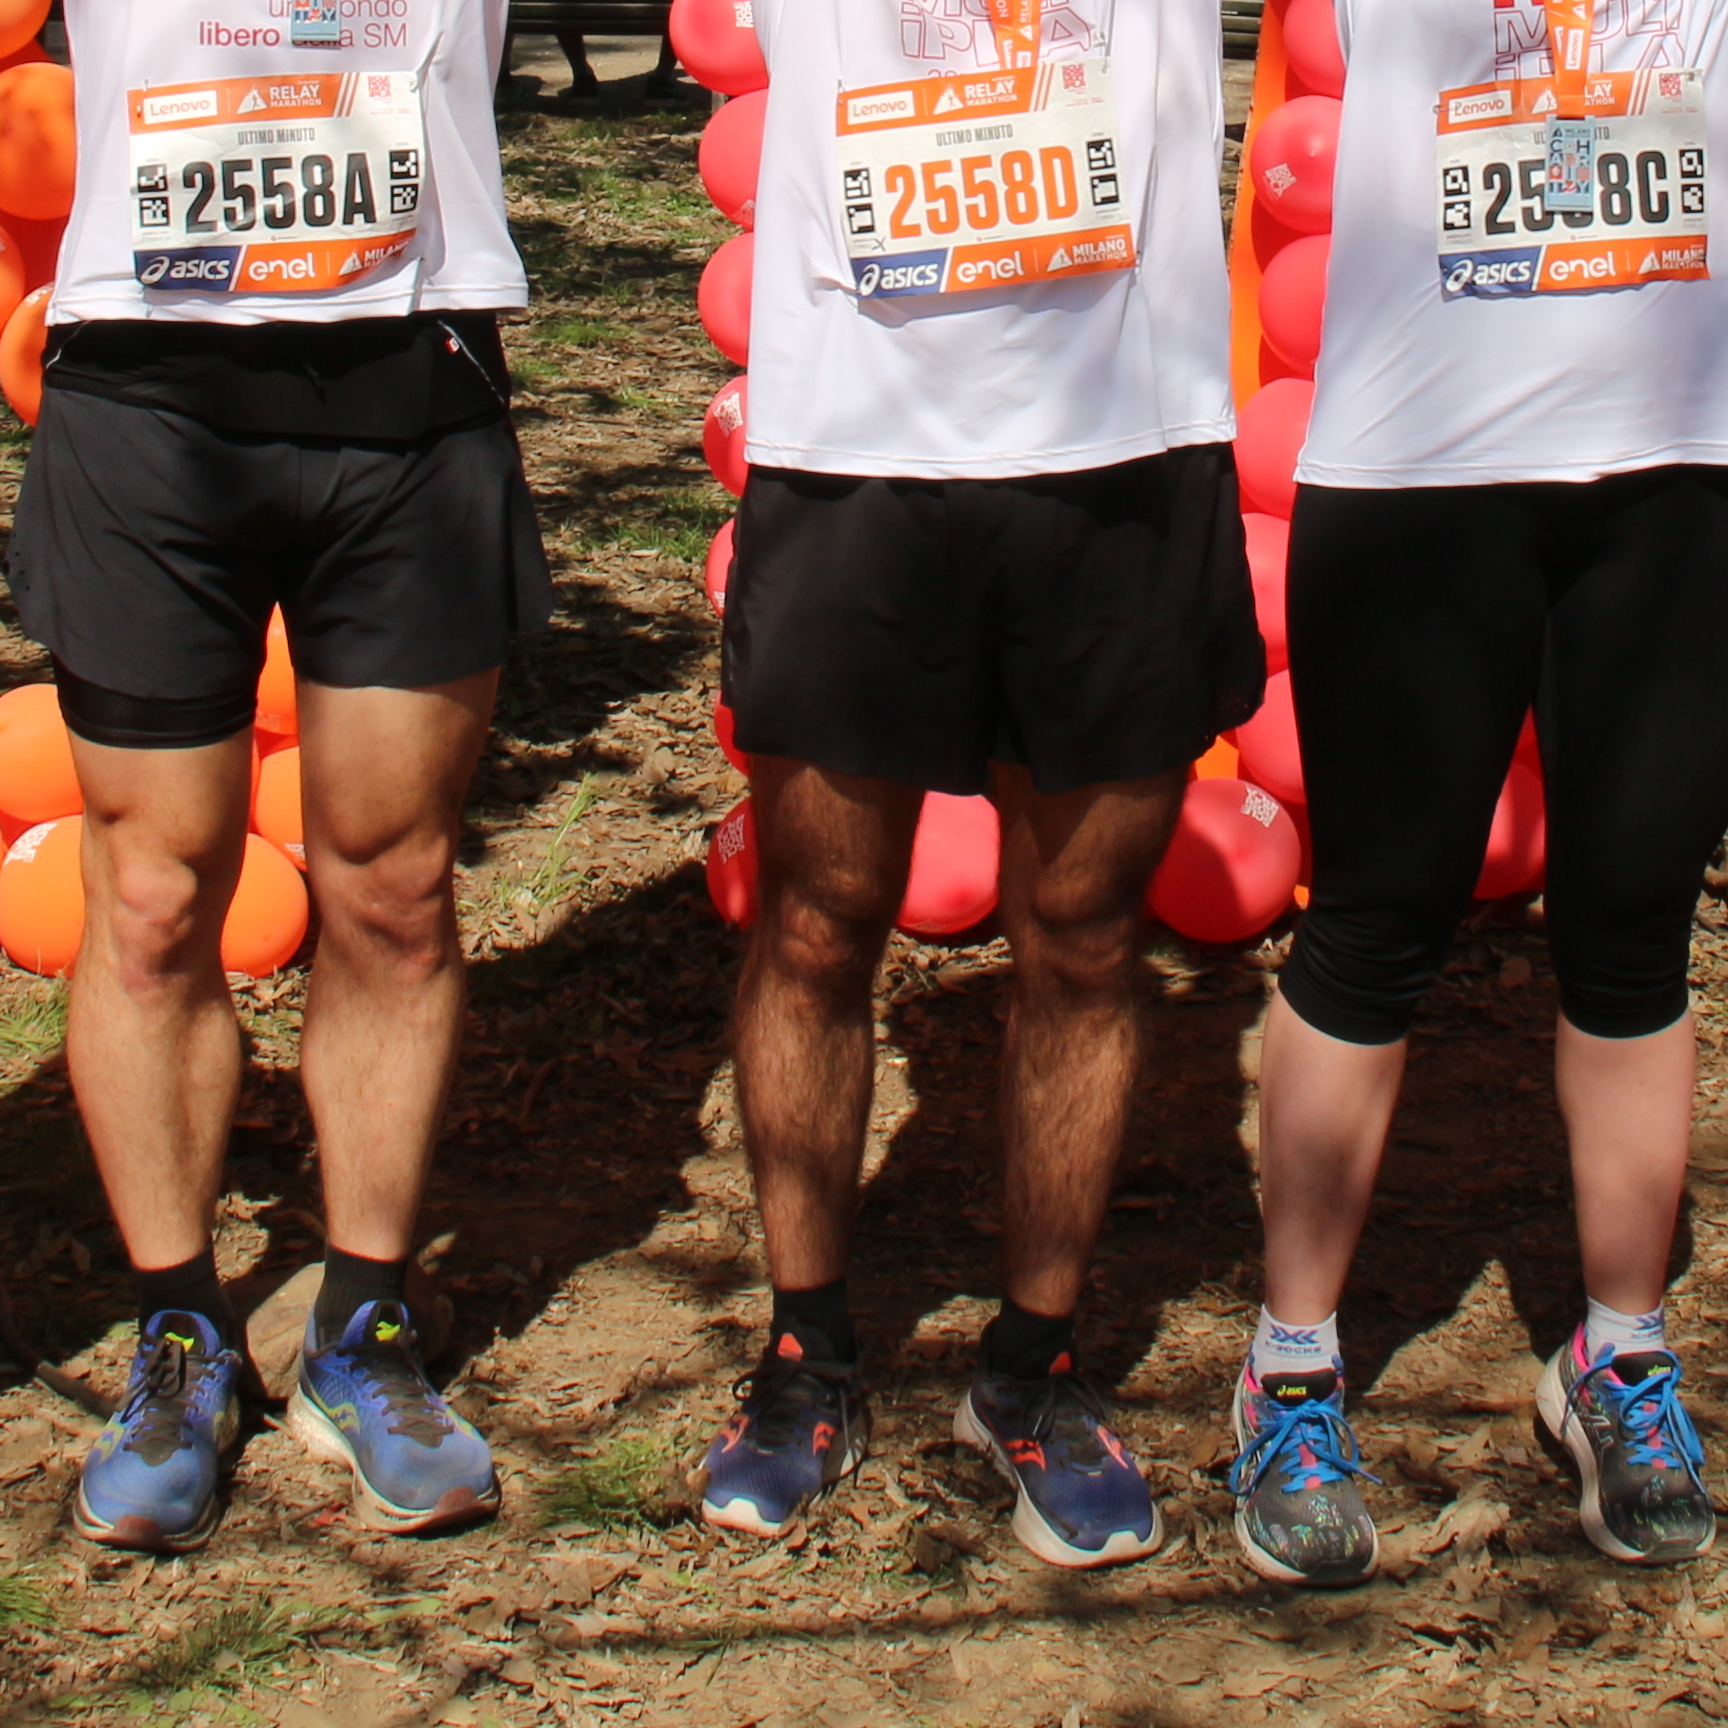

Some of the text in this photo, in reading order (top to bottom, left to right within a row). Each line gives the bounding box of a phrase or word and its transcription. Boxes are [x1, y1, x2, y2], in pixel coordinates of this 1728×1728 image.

[199, 21, 281, 47] libero
[364, 23, 407, 48] SM
[269, 84, 321, 100] RELAY
[964, 79, 1015, 98] RELAY
[149, 97, 210, 117] Lenovo
[270, 98, 322, 109] MARATHON
[852, 98, 907, 118] Lenovo
[966, 94, 1018, 107] MARATHON
[1454, 98, 1506, 117] Lenovo
[237, 127, 315, 146] ULTIMO MINUTO
[936, 124, 1013, 147] ULTIMO MINUTO
[182, 152, 377, 234] 2558A
[884, 145, 1079, 240] 2558D
[1483, 150, 1670, 237] 258C
[1072, 237, 1126, 258] MILANO
[248, 252, 316, 282] enel
[957, 251, 1025, 283] enel
[1549, 251, 1617, 281] enel
